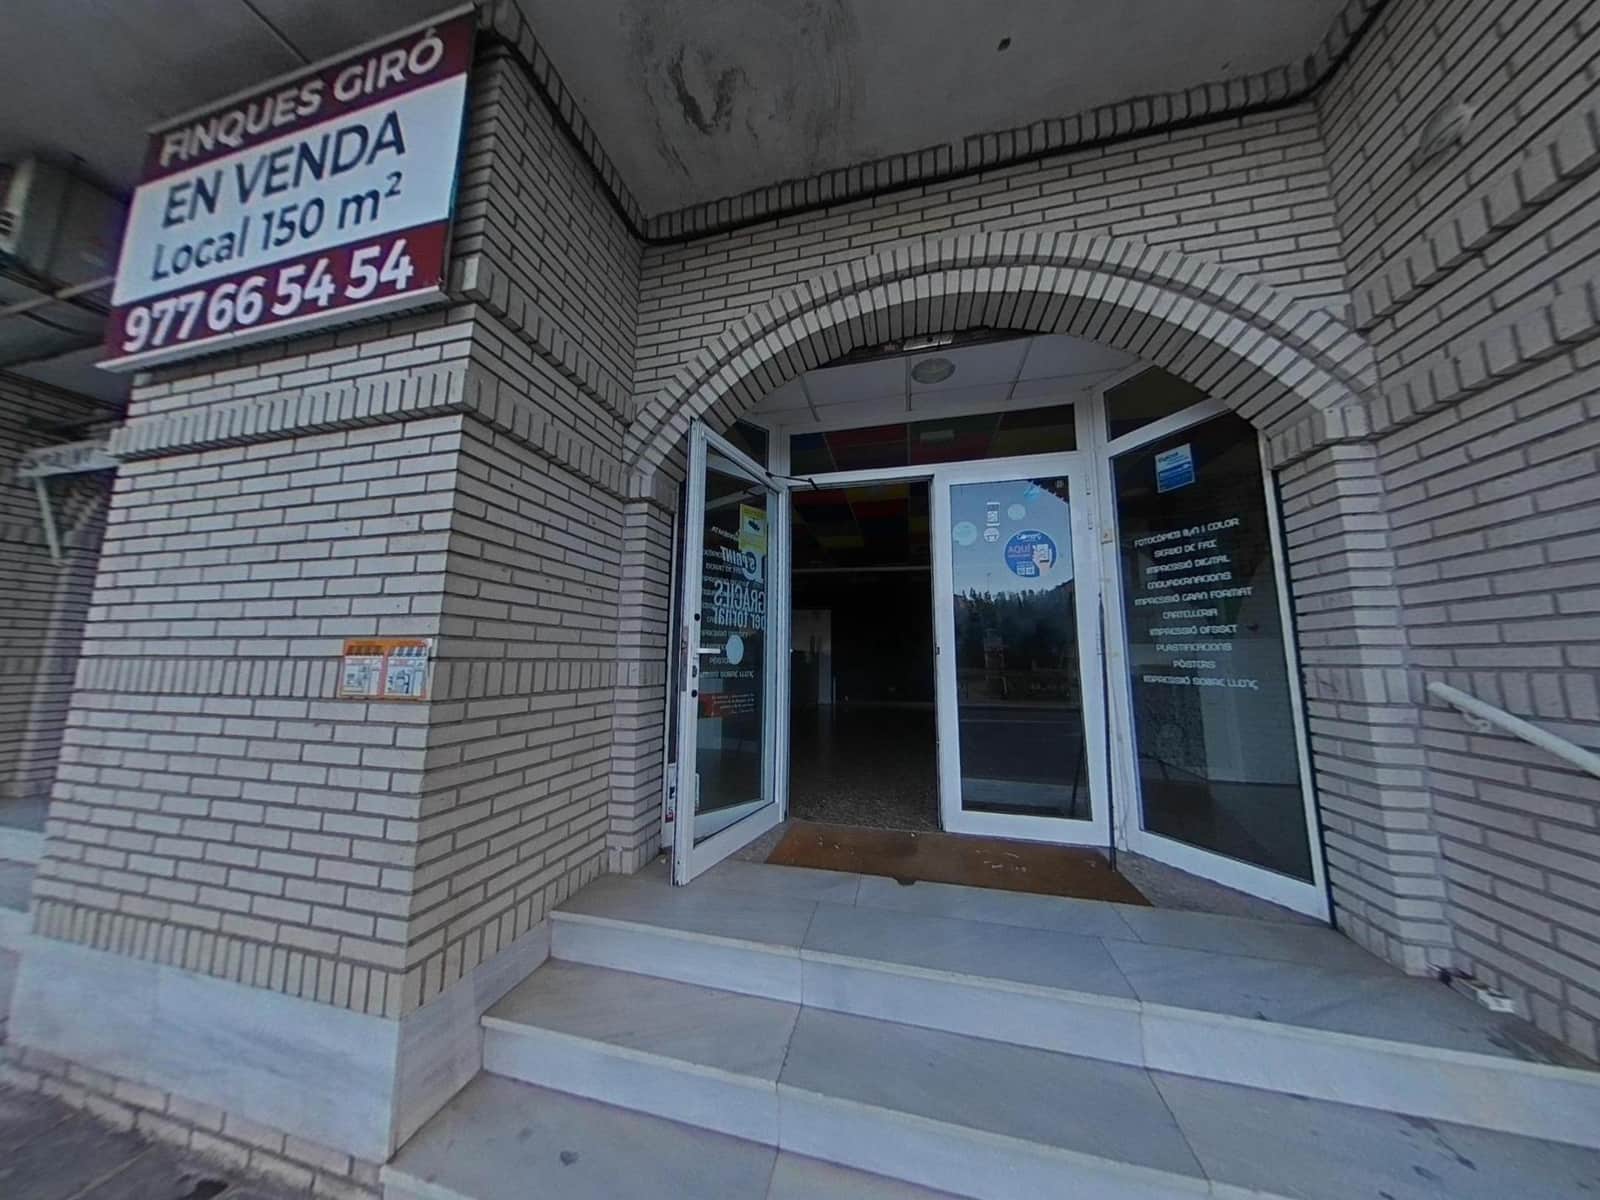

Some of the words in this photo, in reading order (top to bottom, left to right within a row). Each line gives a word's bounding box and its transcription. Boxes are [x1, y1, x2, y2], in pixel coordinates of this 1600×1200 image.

[160, 80, 325, 168] FINQUES
[333, 29, 444, 102] GIRÓ
[161, 169, 222, 229] EN
[235, 110, 406, 205] VENDA
[151, 215, 250, 282] Local
[261, 199, 325, 252] 150
[122, 290, 206, 353] 977
[207, 276, 267, 332] 66
[271, 257, 335, 317] 54
[345, 238, 414, 299] 54
[1194, 554, 1231, 567] DIGITAL
[1207, 518, 1240, 531] COLOR
[1182, 591, 1208, 602] GRAN
[1210, 586, 1252, 599] FORMAT
